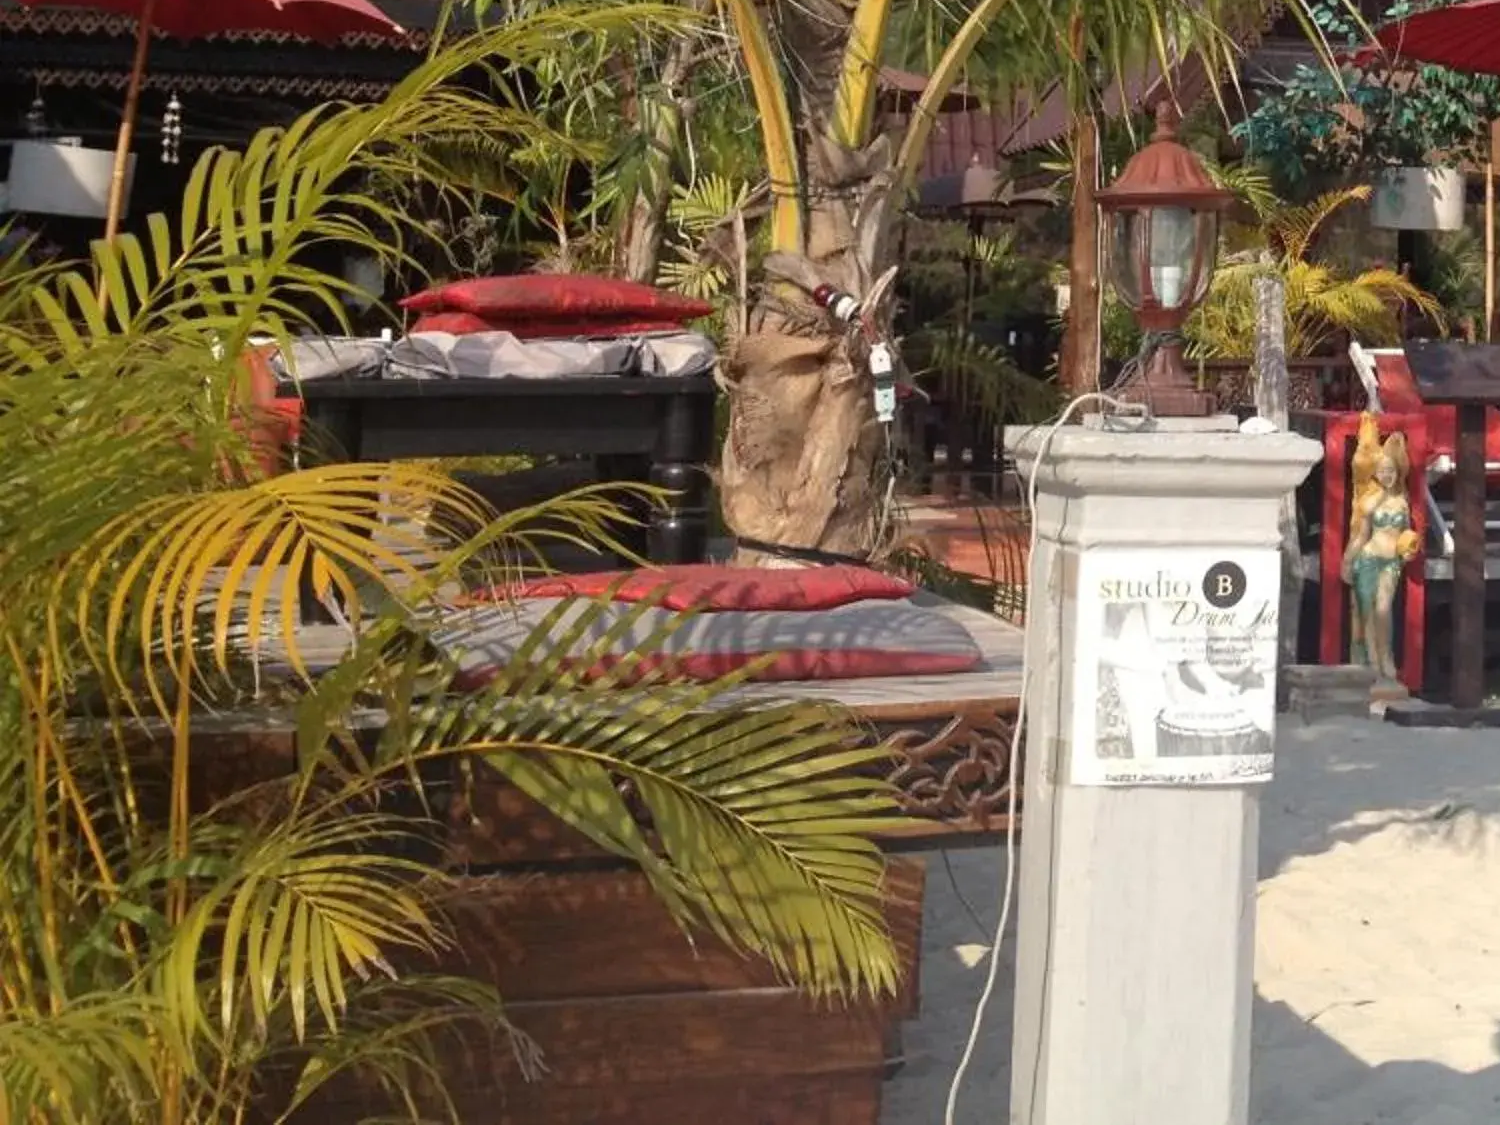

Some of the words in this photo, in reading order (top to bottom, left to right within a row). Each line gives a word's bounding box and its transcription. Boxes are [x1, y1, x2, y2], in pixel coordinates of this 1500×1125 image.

[1098, 570, 1192, 599] studio
[1216, 574, 1233, 597] B
[1167, 600, 1238, 627] Drum
